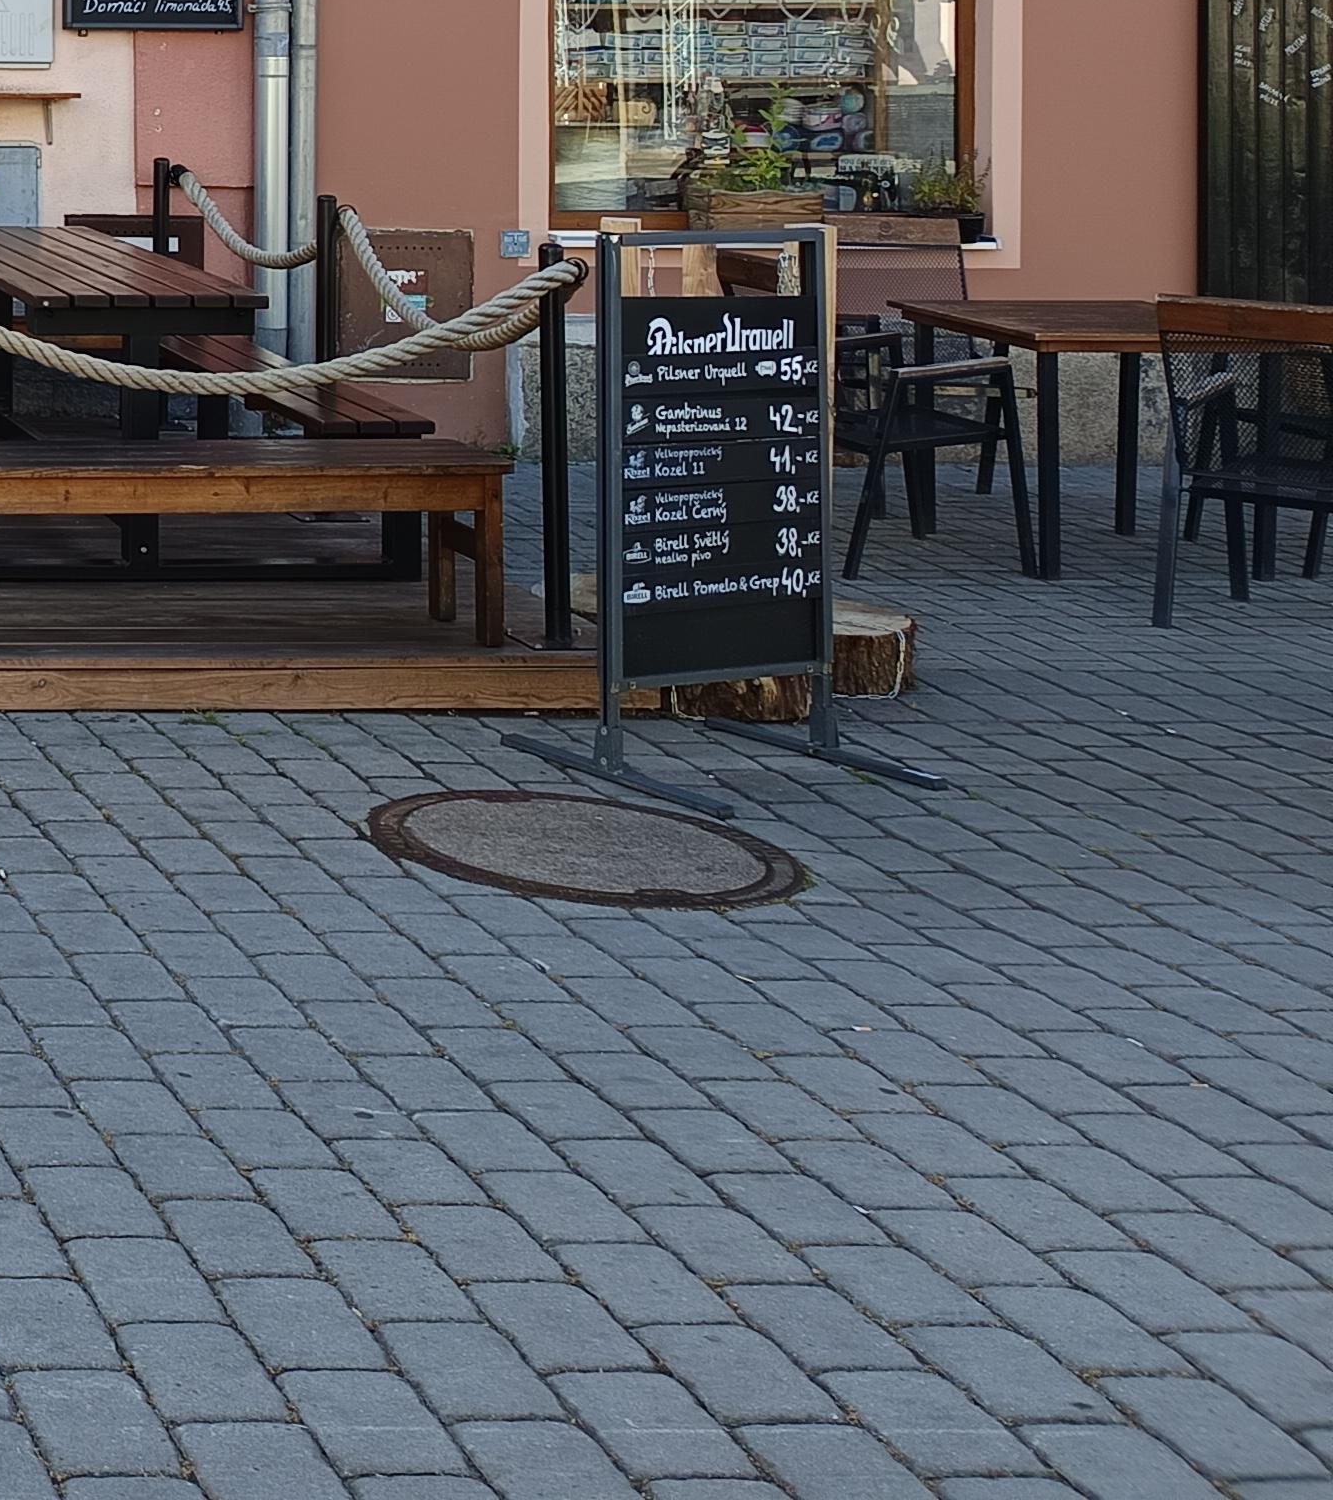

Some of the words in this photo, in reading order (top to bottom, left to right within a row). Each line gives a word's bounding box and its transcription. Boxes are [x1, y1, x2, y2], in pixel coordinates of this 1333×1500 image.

[657, 366, 700, 381] Pilsner
[705, 362, 748, 386] Urquell
[806, 360, 819, 373] Kč
[655, 402, 722, 420] Gambrinus
[806, 410, 819, 423] Kč
[655, 417, 731, 439] Nepasterizovaná
[735, 416, 748, 431] 12
[654, 446, 723, 462] Velkopopovický
[654, 462, 687, 477] Kozel
[692, 464, 706, 476] 11
[806, 449, 819, 463] Kč
[654, 508, 688, 523] Kozel
[692, 502, 727, 524] Černý
[806, 490, 819, 504] Kč
[655, 488, 724, 505] Velkopopovický
[654, 535, 689, 552] Birell
[693, 530, 730, 554] Světlý
[807, 530, 821, 543] Kč
[655, 553, 688, 565] nealko
[691, 551, 712, 568] pivo
[655, 582, 689, 600] Birell
[693, 578, 738, 597] Pomelo
[739, 576, 748, 592] &
[749, 575, 780, 597] Grep
[808, 571, 821, 585] Kč
